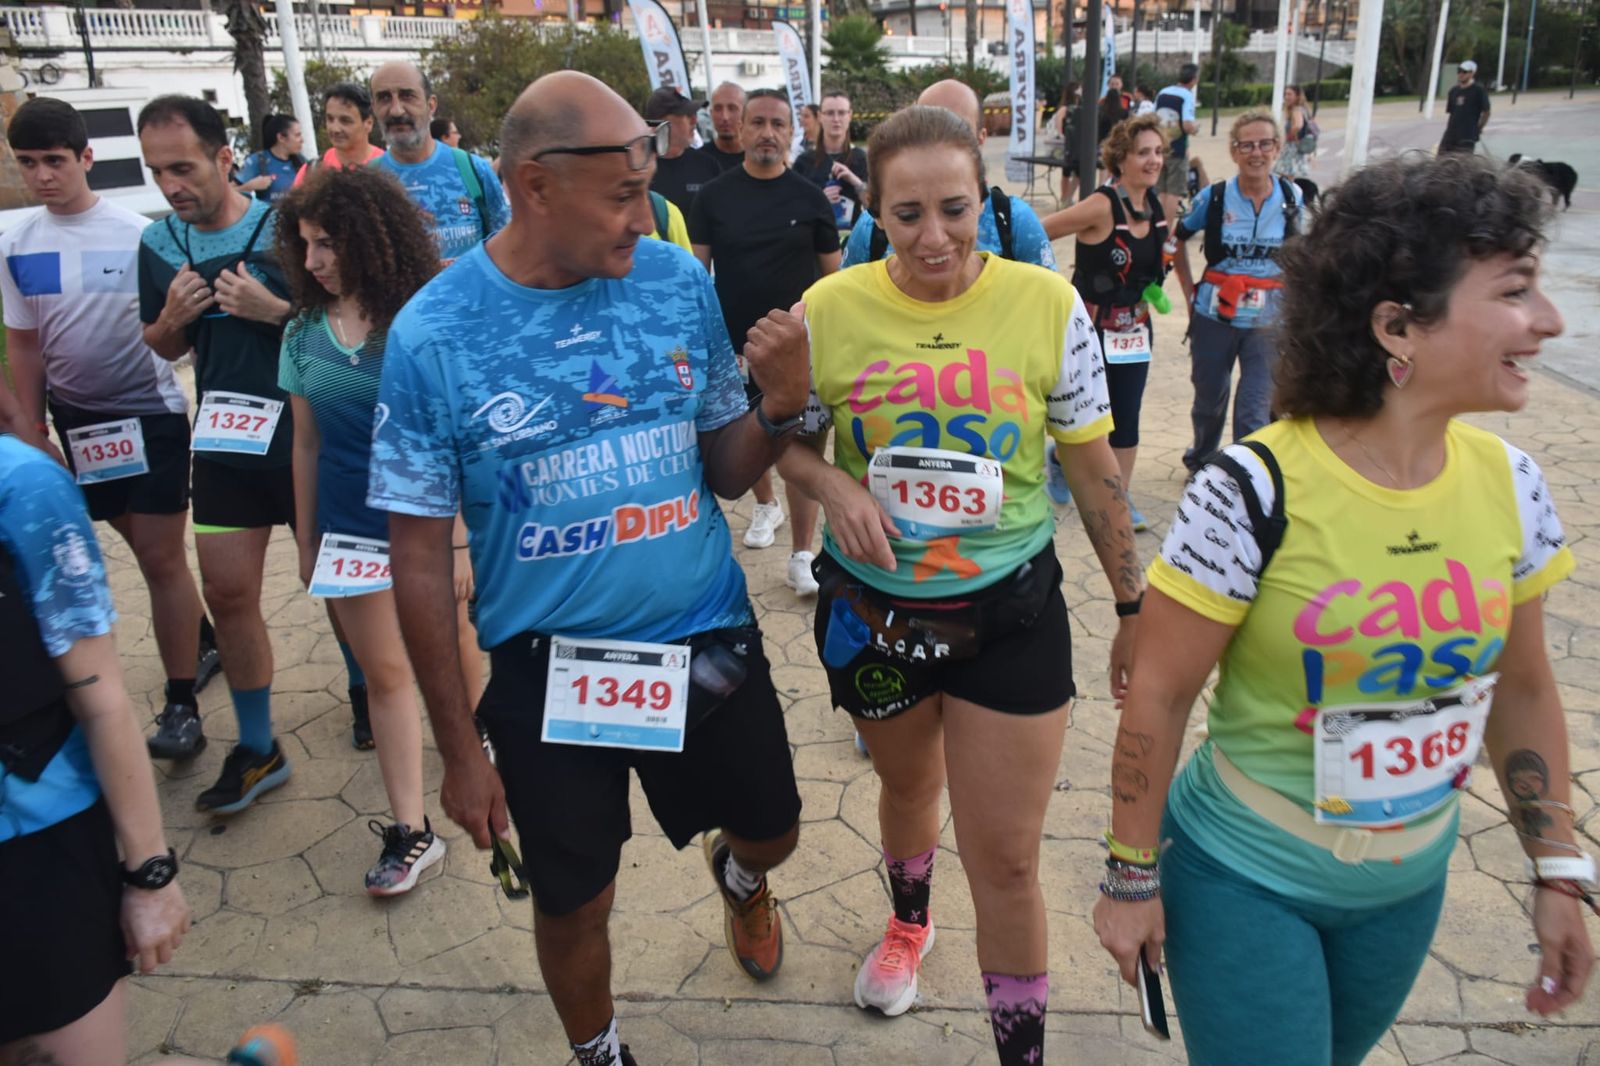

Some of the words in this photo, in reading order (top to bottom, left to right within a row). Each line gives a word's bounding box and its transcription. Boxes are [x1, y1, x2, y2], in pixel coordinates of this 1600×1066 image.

[1112, 336, 1144, 350] 1373
[849, 349, 1029, 423] cada
[209, 411, 269, 433] 1327
[82, 439, 133, 463] 1330
[521, 444, 617, 487] CARRERA
[626, 464, 656, 487] DE
[891, 480, 986, 516] 1363
[571, 675, 672, 711] 1349
[1350, 721, 1470, 780] 1368
